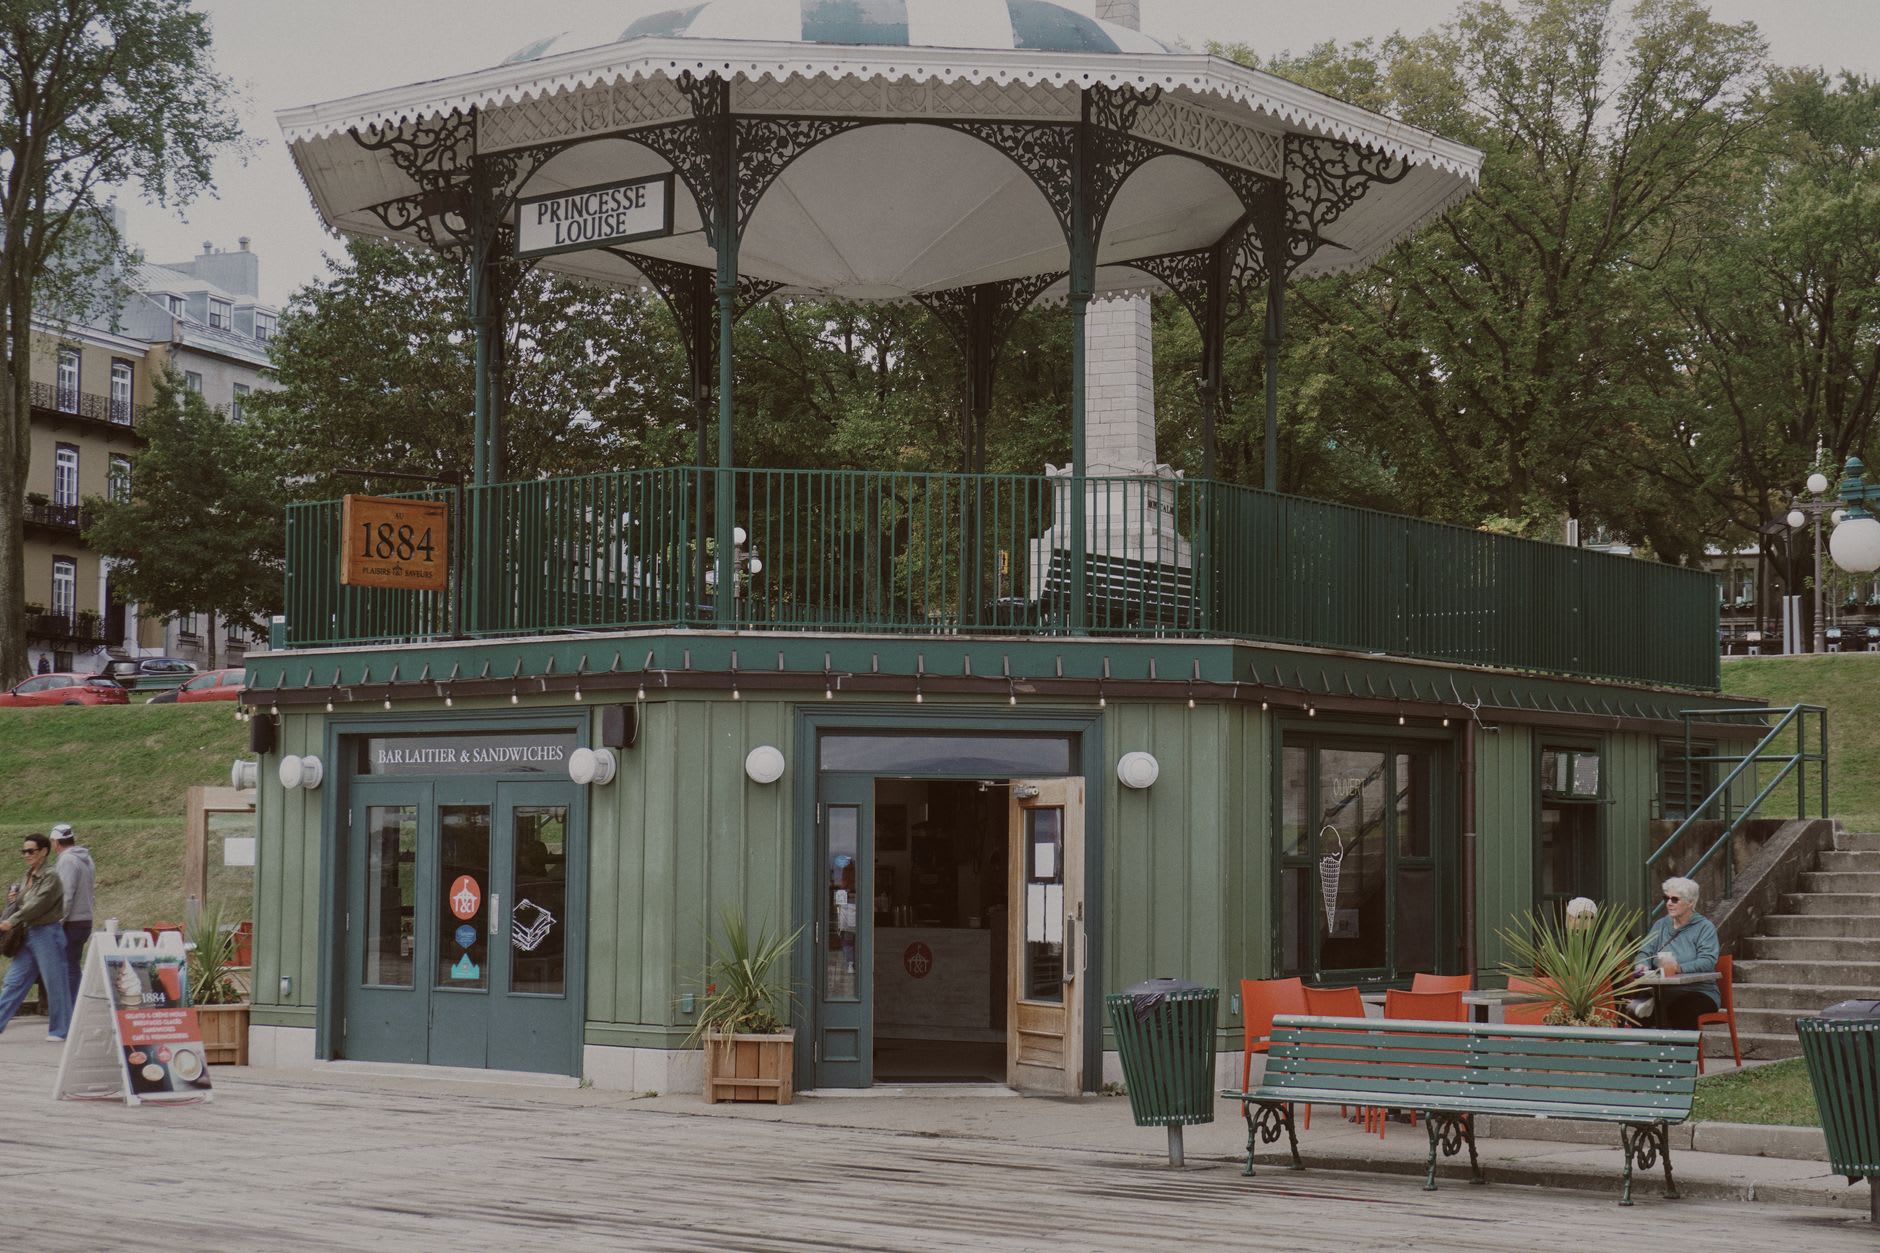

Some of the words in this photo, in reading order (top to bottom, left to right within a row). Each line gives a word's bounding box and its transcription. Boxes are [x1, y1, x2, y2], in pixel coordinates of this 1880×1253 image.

[537, 185, 646, 225] PRINCESSE
[555, 212, 627, 245] LOUISE
[361, 522, 435, 562] 1884
[362, 567, 390, 576] PLAISIRS
[404, 570, 432, 578] SAVEURS
[378, 749, 402, 764] BAR
[405, 748, 456, 763] LAITIER
[460, 750, 470, 763] &
[473, 746, 563, 763] SANDWICHES
[1333, 778, 1366, 796] OUVERT
[142, 992, 165, 1003] 1884
